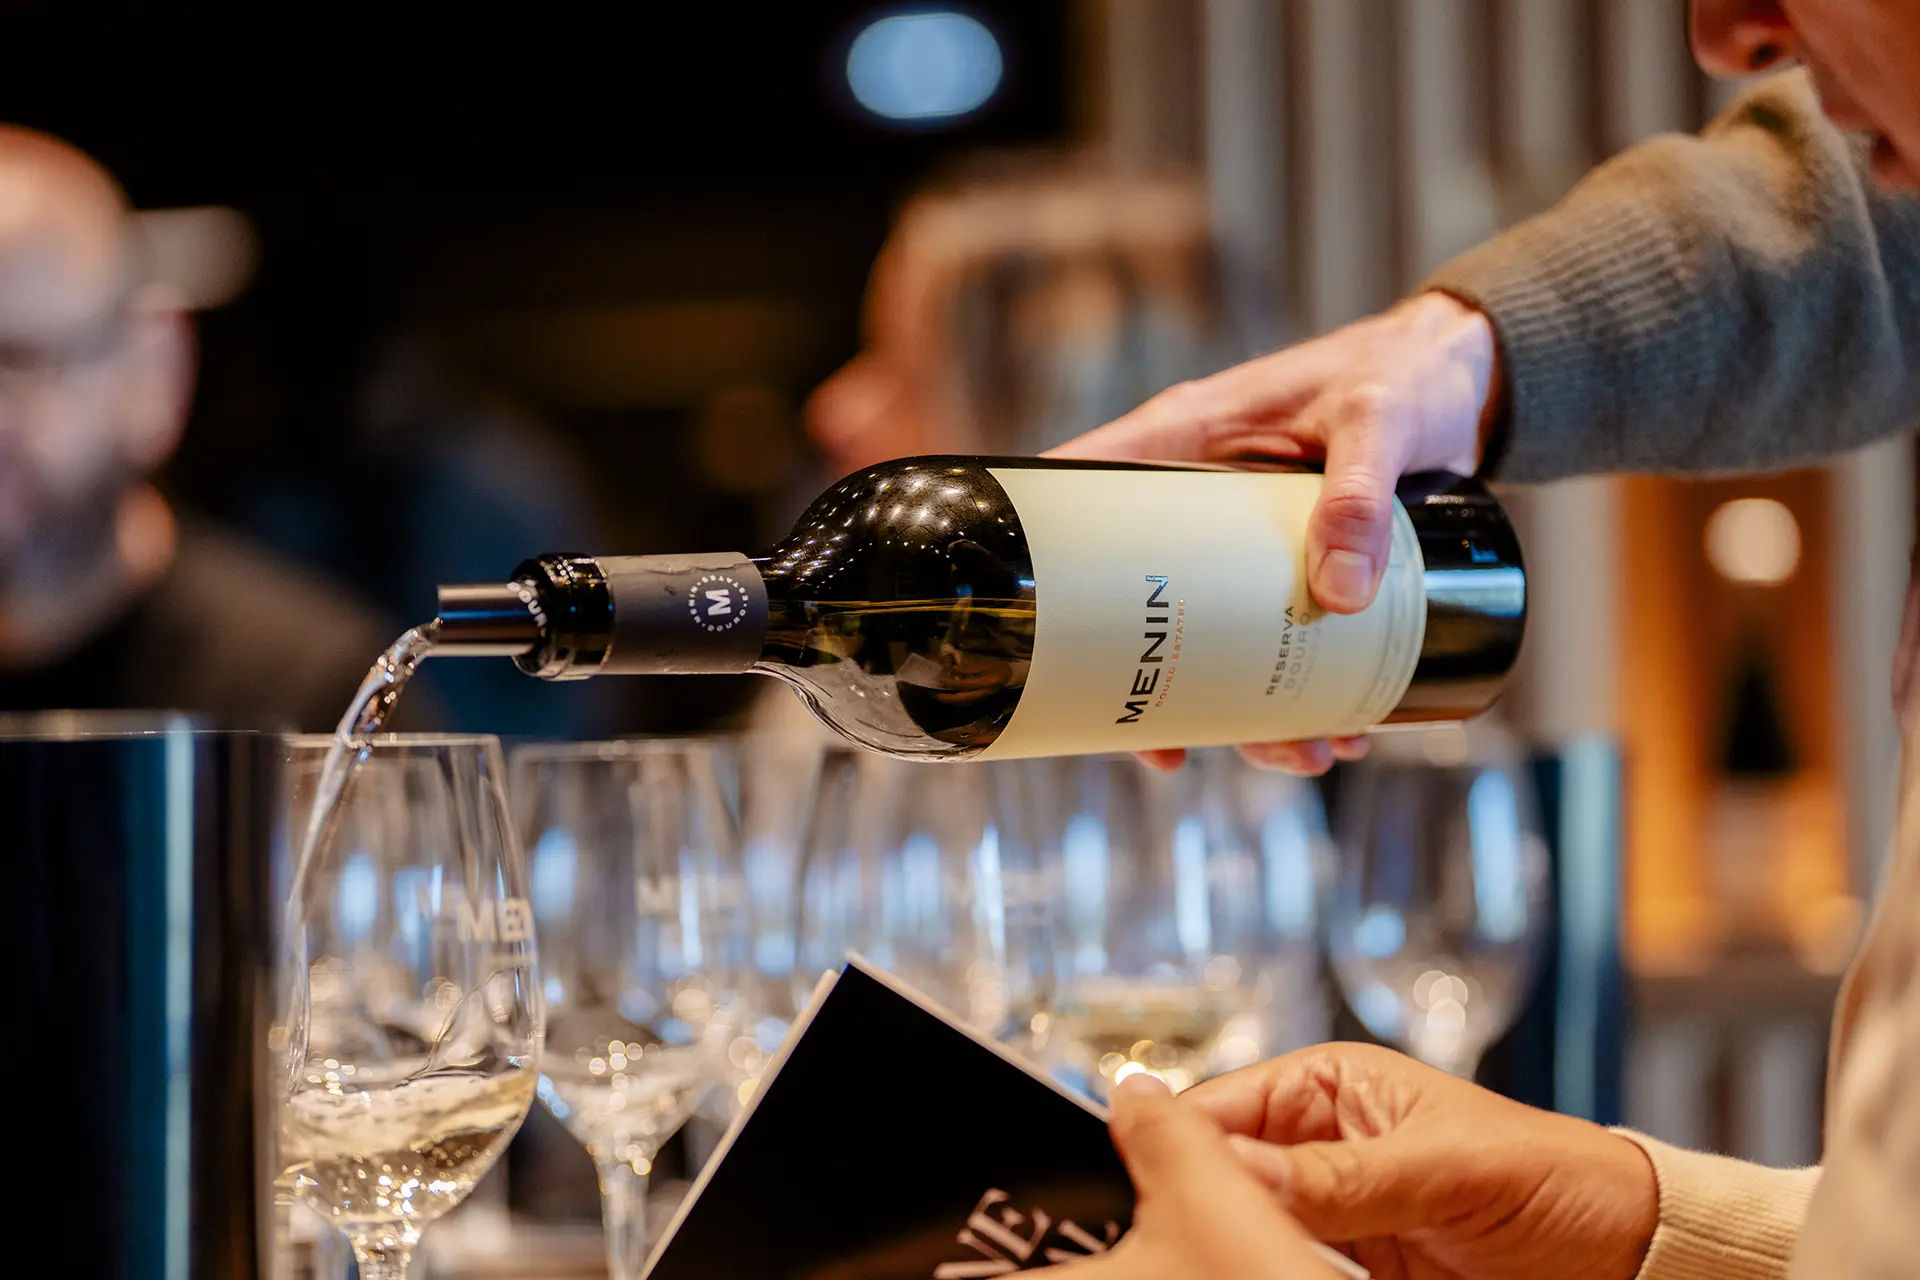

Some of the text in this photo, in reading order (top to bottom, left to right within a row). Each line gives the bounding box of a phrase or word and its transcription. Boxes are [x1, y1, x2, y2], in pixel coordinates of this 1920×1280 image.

[705, 589, 731, 616] M
[1115, 575, 1169, 725] MENIN
[1155, 599, 1185, 707] DOURO ESTATES
[1264, 605, 1294, 696] RESERVA
[1282, 612, 1311, 691] DOURO
